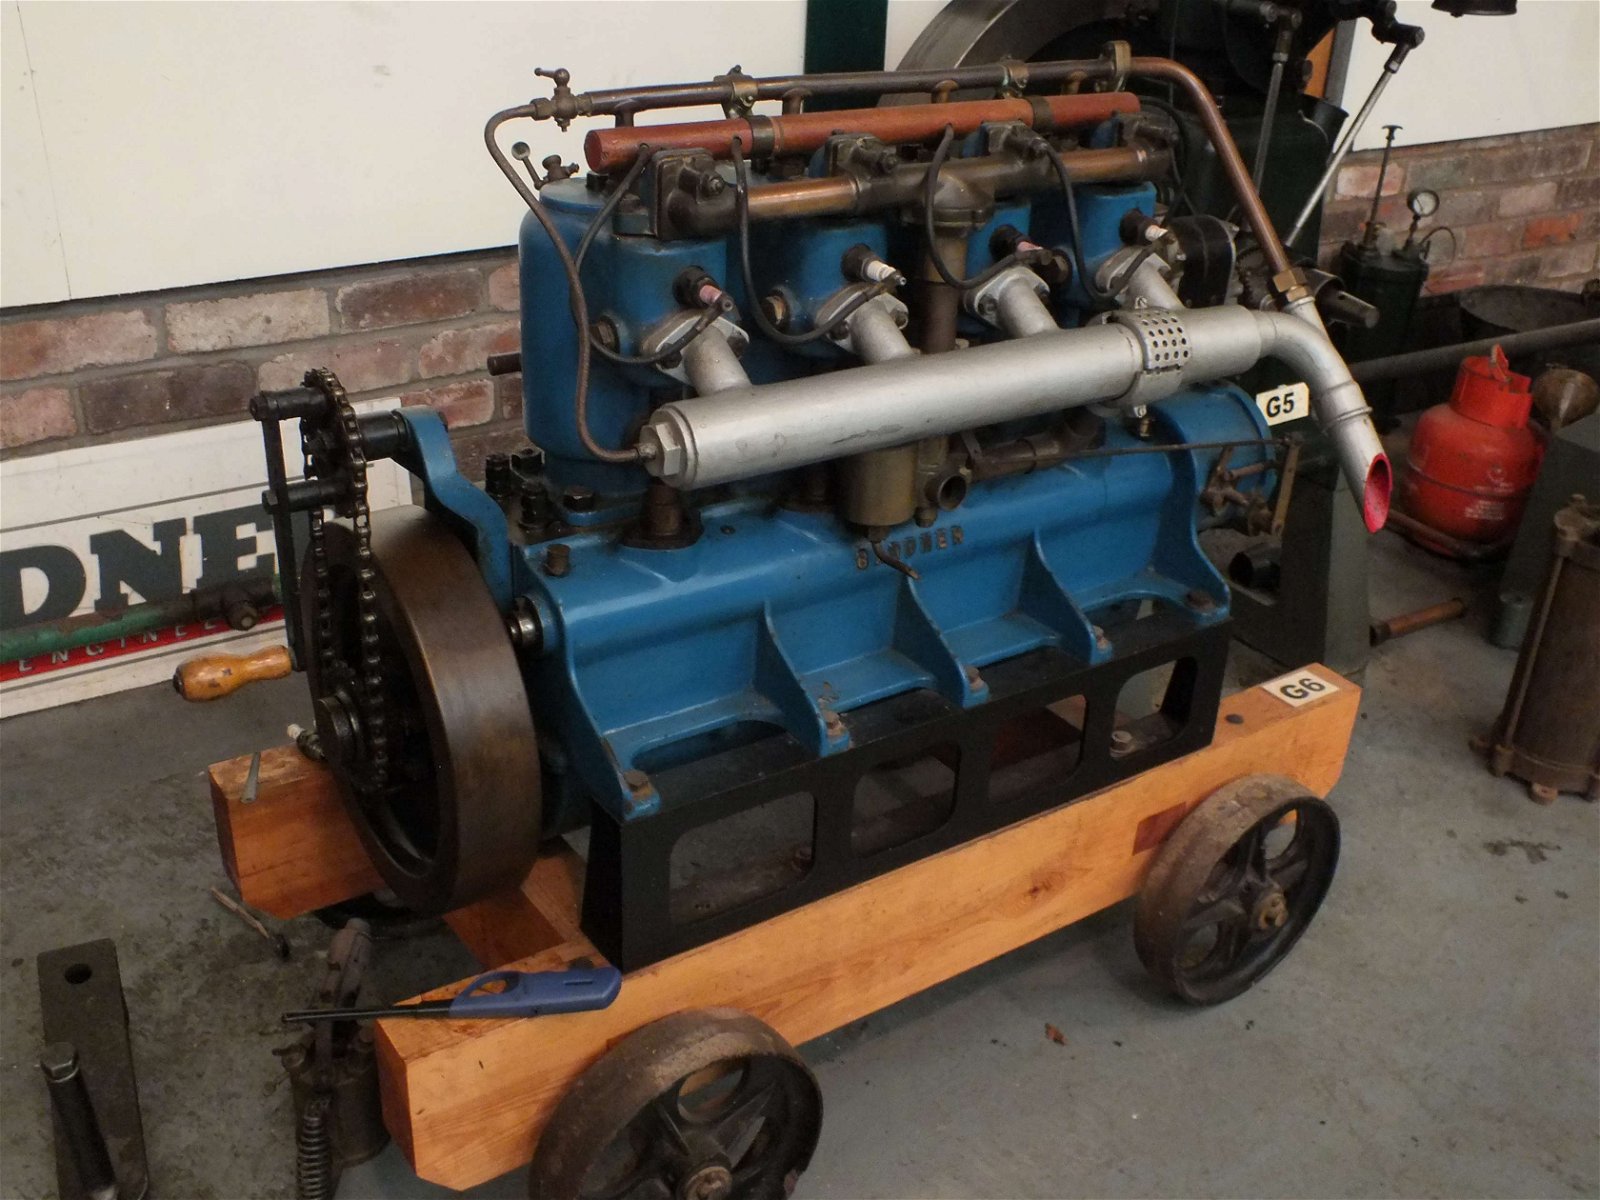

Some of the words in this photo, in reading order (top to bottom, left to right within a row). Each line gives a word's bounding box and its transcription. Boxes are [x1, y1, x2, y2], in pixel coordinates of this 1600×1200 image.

[1265, 385, 1295, 419] G5
[0, 502, 298, 628] DNE
[1279, 677, 1327, 700] G6
